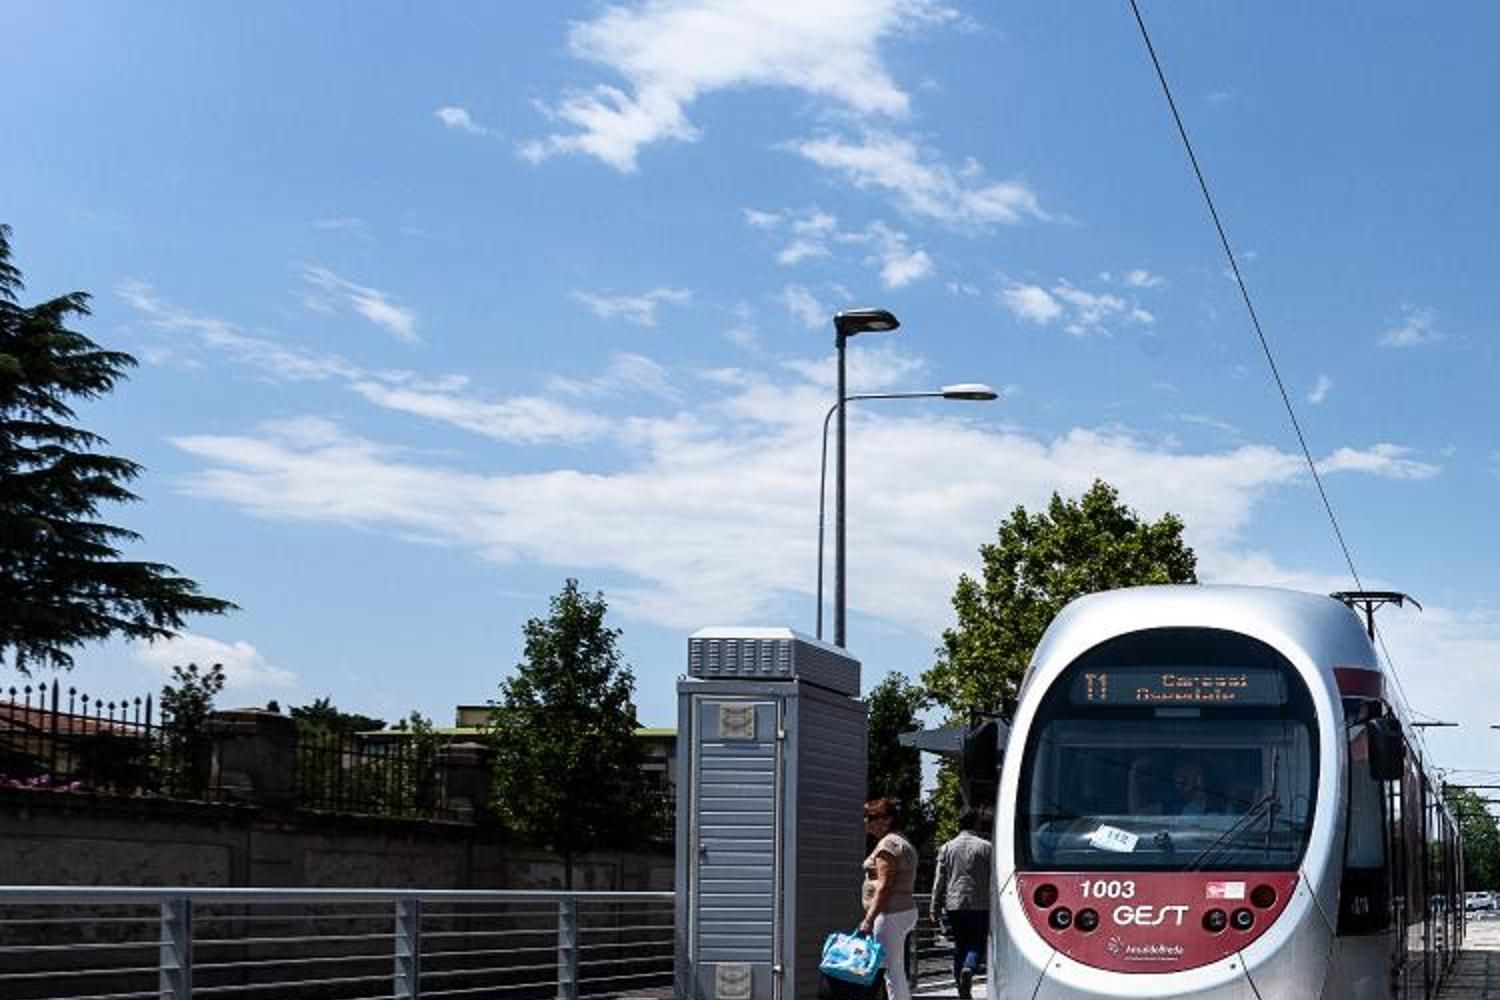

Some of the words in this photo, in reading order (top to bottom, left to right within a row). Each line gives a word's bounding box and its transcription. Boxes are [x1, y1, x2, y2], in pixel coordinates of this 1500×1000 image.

[1084, 673, 1107, 700] T1
[1080, 880, 1136, 898] 1003
[1113, 905, 1189, 926] GEST
